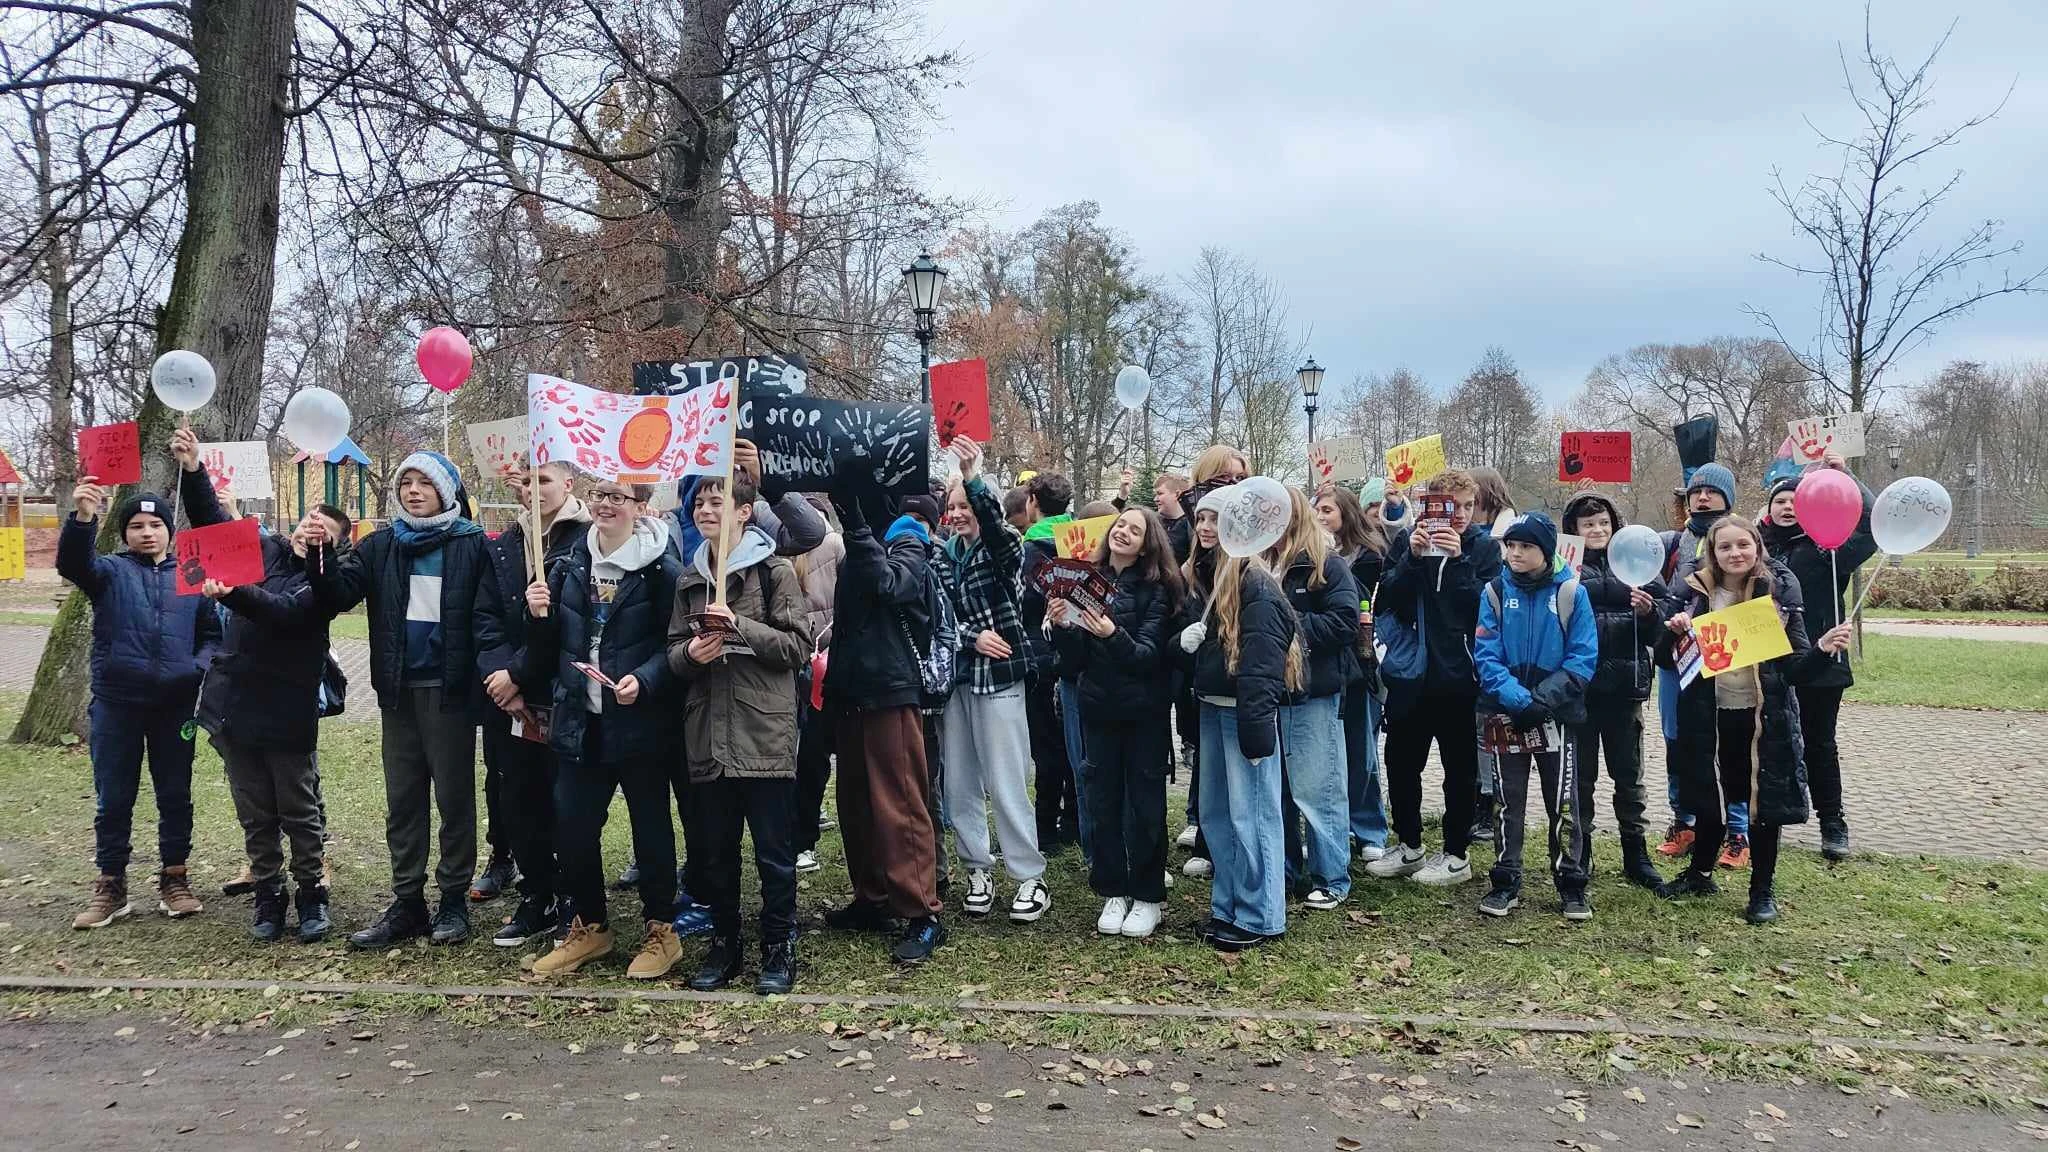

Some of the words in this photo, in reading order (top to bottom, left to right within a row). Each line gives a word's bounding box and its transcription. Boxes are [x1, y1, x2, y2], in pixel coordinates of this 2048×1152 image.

[669, 358, 760, 391] STOP
[765, 406, 821, 428] STOP
[98, 431, 130, 445] STOP
[1592, 435, 1619, 445] STOP
[1240, 491, 1281, 518] STOP
